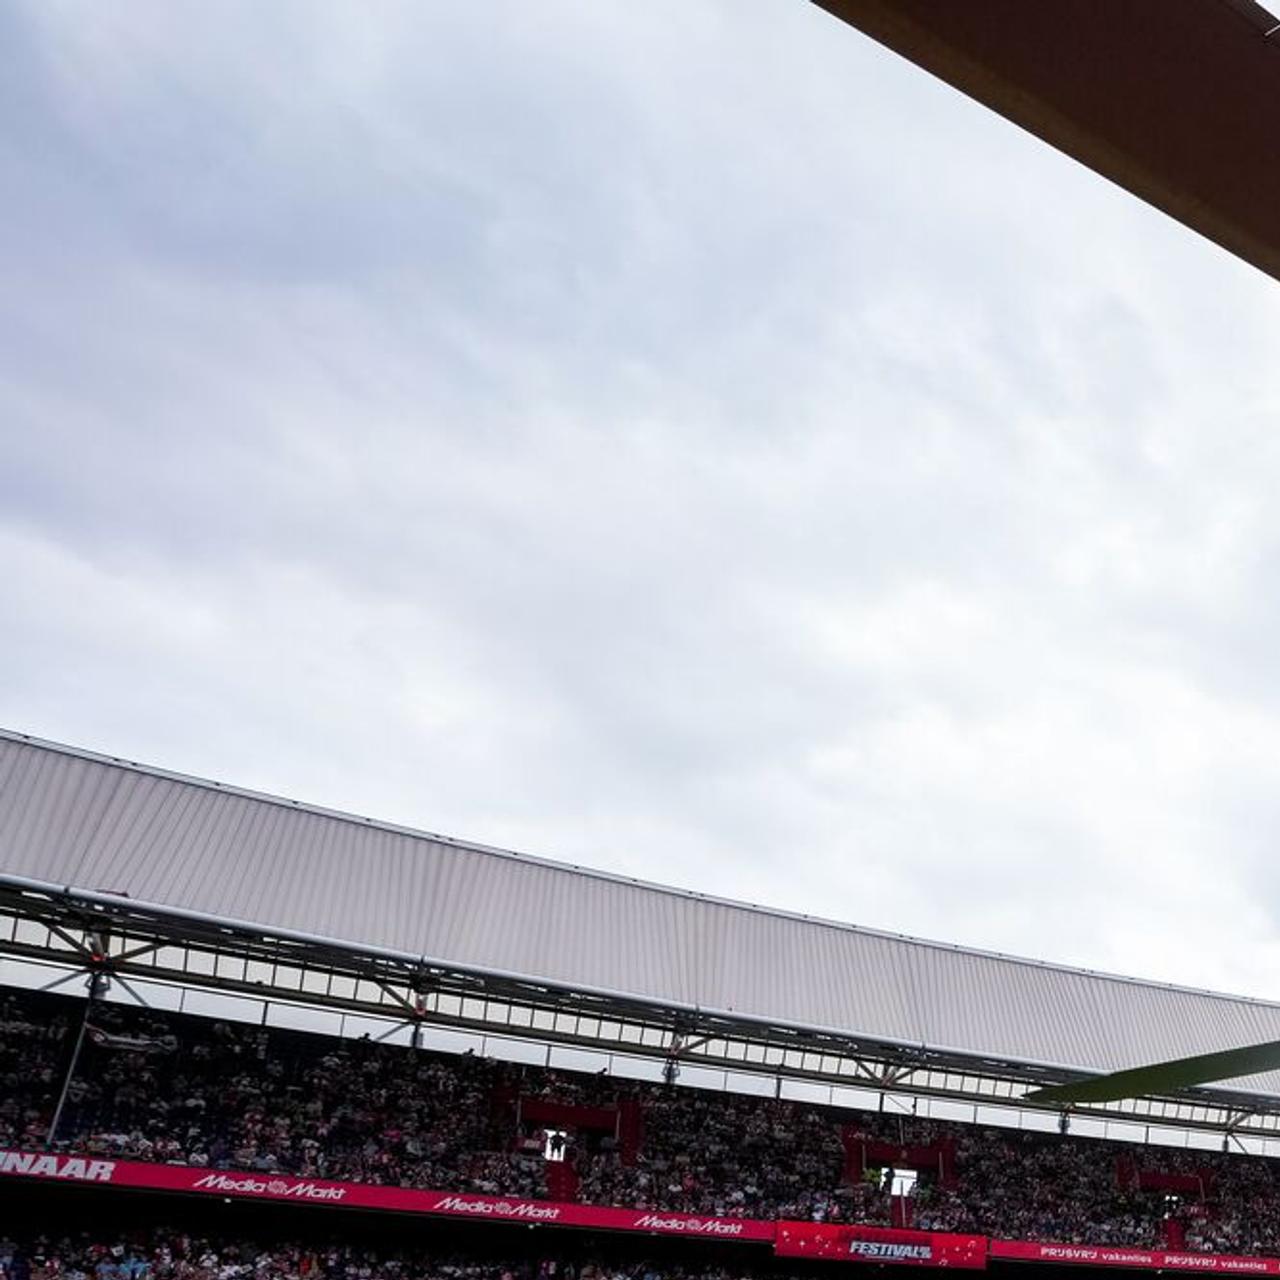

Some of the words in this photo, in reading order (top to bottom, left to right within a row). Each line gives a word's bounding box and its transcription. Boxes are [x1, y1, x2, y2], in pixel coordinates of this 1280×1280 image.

[193, 1174, 267, 1193] Media
[285, 1182, 347, 1200] Markt
[433, 1197, 494, 1214] Media
[509, 1203, 560, 1220] Markt
[634, 1214, 686, 1231] Media
[700, 1220, 744, 1235] Markt
